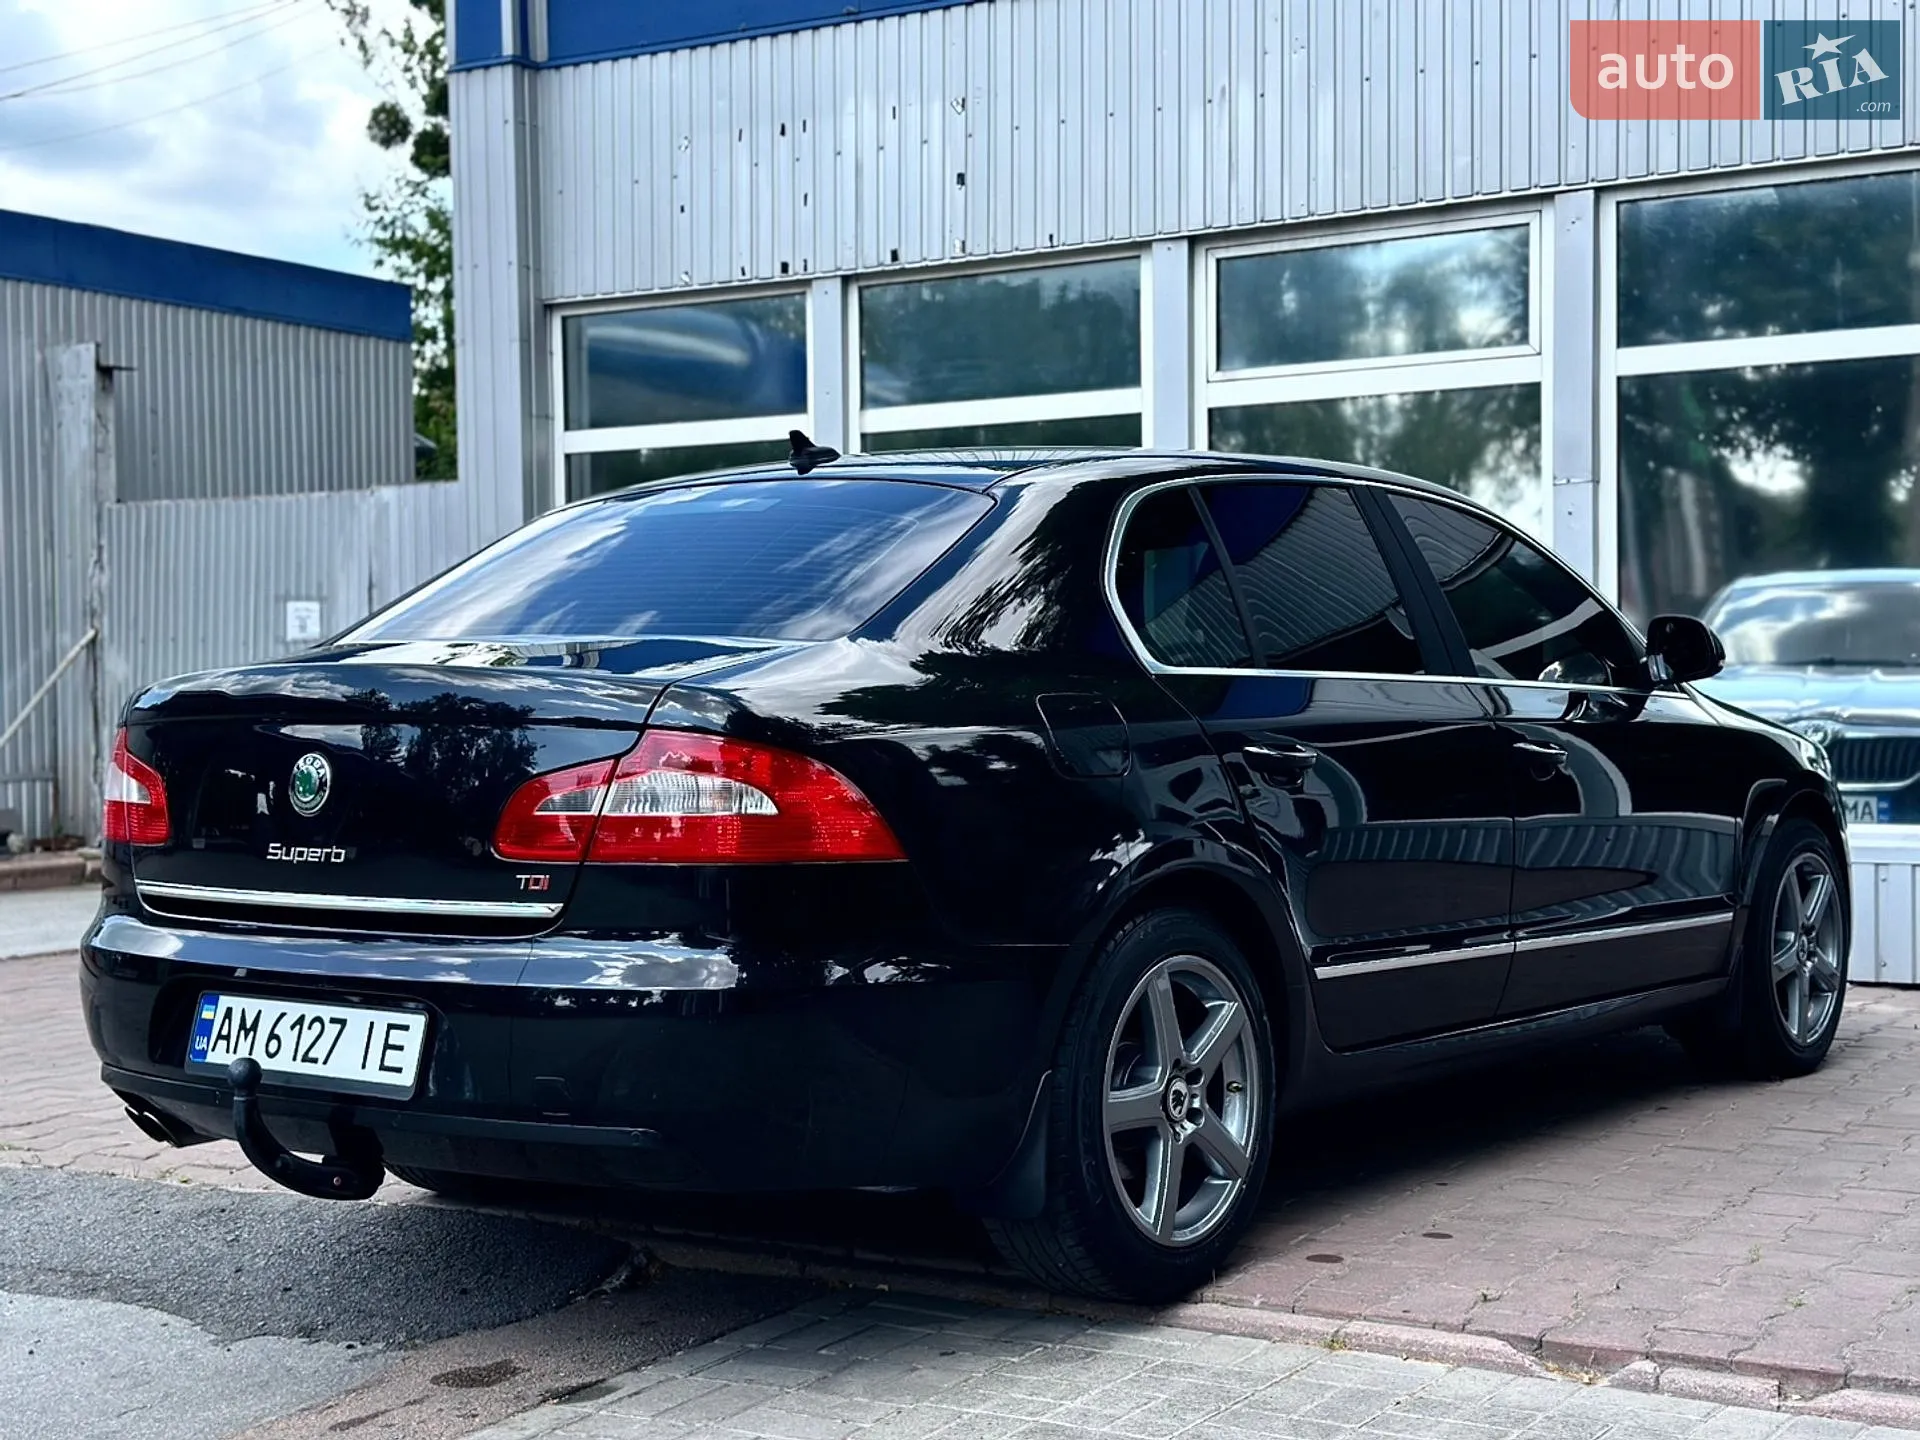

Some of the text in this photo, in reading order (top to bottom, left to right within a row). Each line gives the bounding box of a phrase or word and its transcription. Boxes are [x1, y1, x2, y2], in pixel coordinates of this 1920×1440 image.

[266, 842, 346, 864] Superb
[195, 1036, 208, 1051] UA
[211, 1006, 411, 1074] AM 6127 IE
